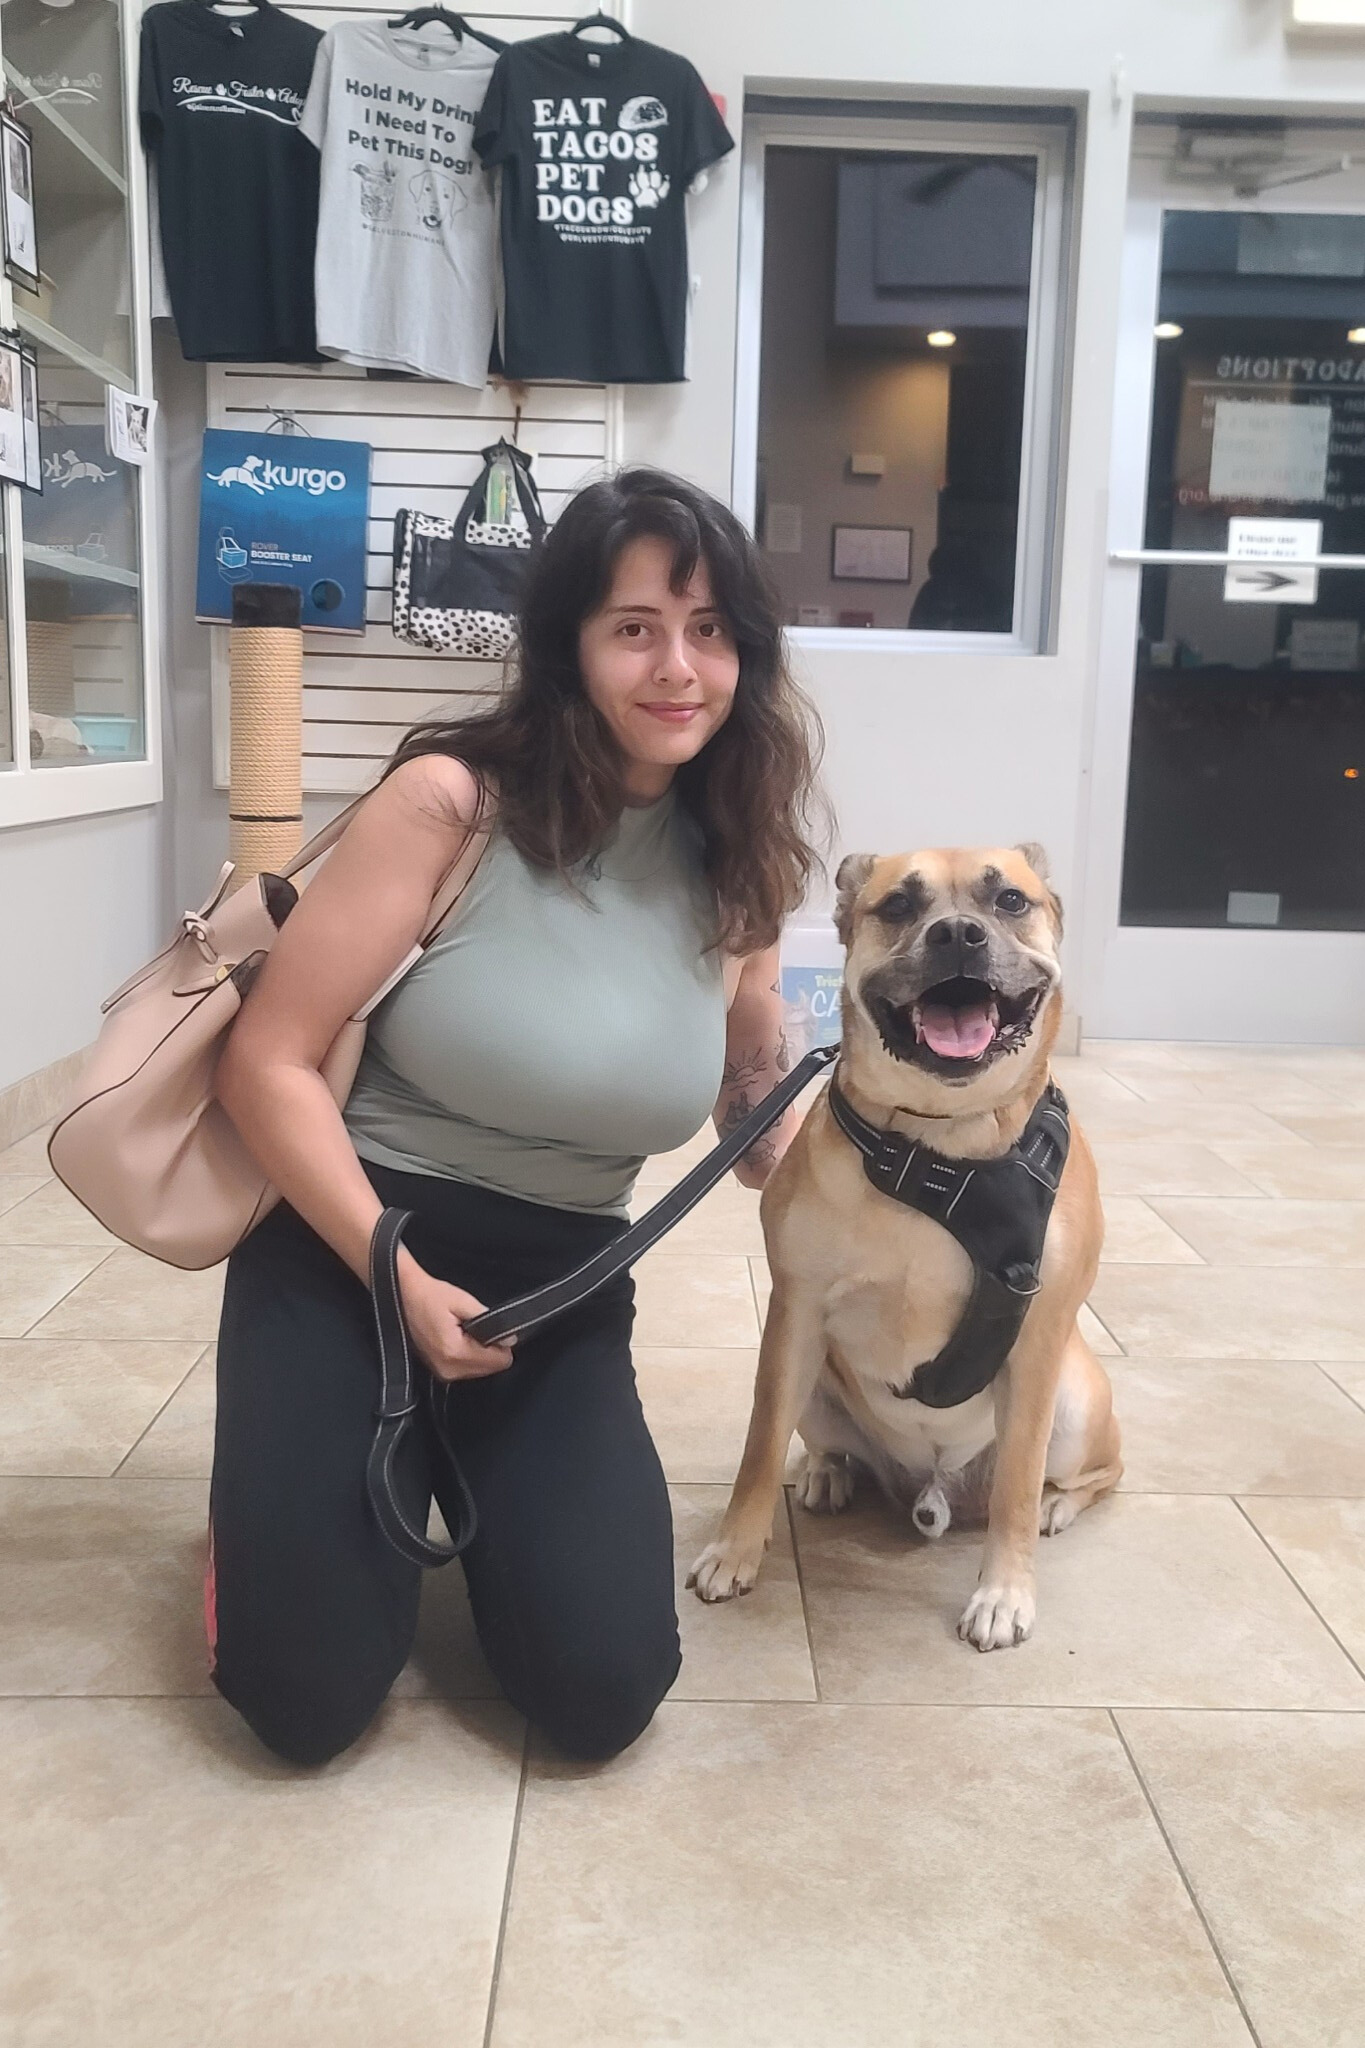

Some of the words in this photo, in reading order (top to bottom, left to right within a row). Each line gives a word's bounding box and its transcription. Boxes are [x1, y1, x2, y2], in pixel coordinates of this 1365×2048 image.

[345, 78, 392, 101] Hold
[397, 88, 428, 112] My
[364, 107, 370, 124] I
[376, 110, 427, 136] Need
[432, 123, 457, 143] To
[532, 97, 608, 127] EAT
[348, 129, 380, 152] Pet
[384, 137, 425, 161] This
[430, 147, 473, 176] Dog!
[532, 130, 659, 161] TACOS
[535, 162, 606, 192] PET
[536, 194, 634, 226] DOGS
[262, 459, 347, 496] kurgo
[251, 542, 279, 551] ROVER
[251, 550, 290, 561] BOOSTER
[291, 553, 313, 563] SEAT
